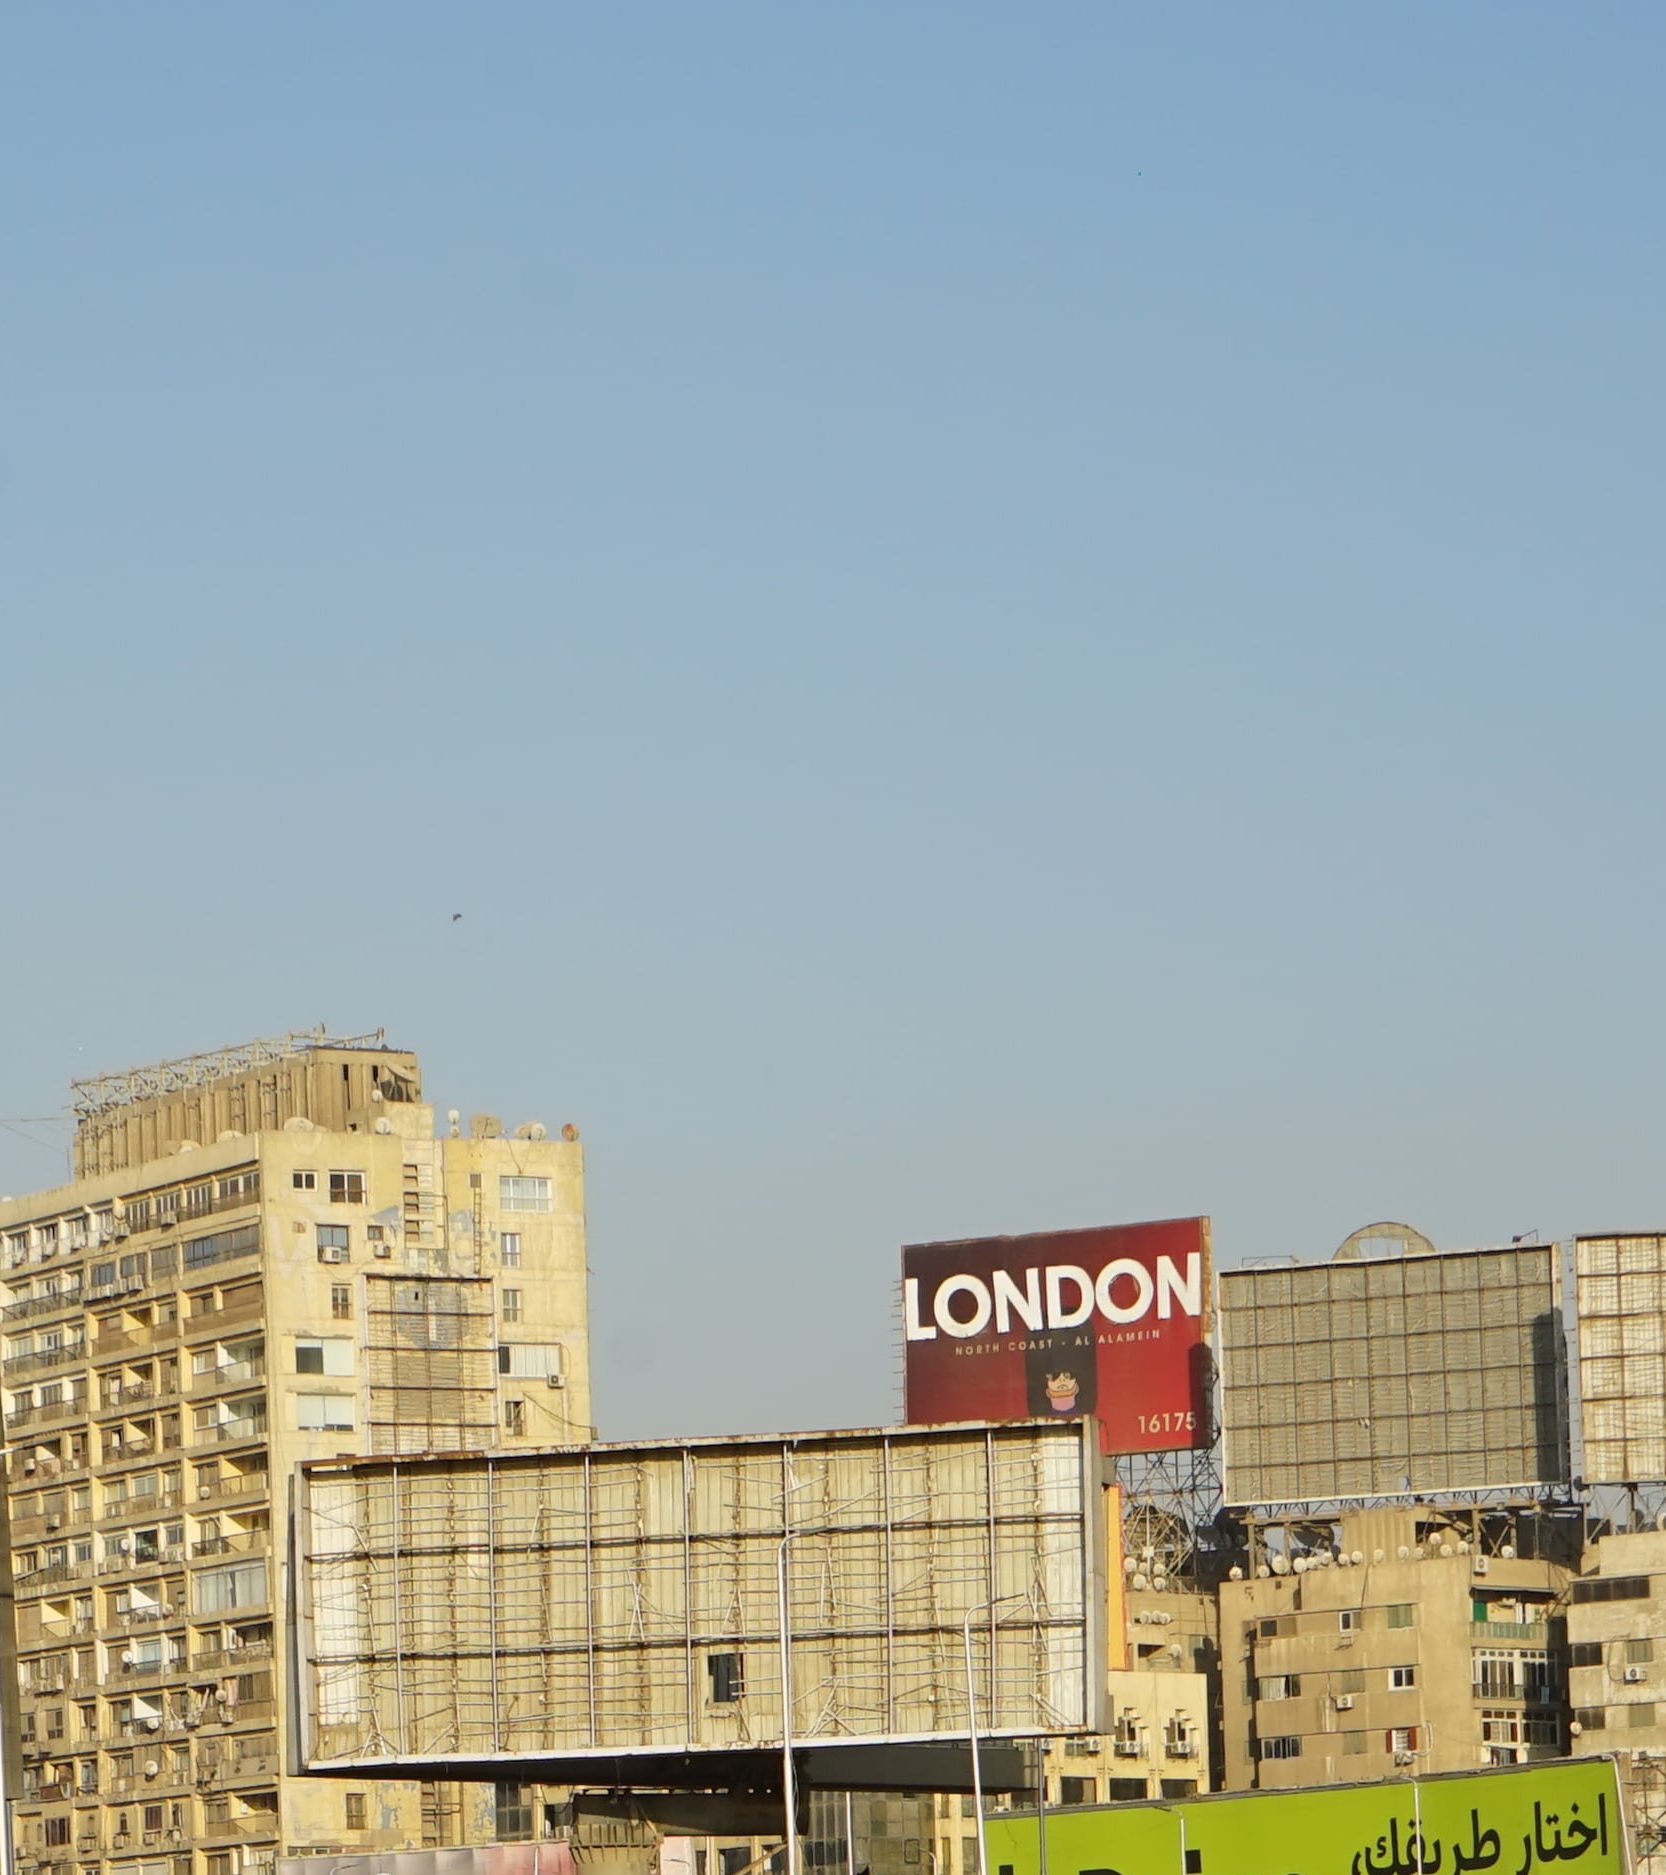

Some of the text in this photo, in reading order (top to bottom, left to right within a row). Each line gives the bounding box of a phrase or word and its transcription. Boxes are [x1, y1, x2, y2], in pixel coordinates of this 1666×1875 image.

[904, 1251, 1202, 1342] LONDON
[955, 1329, 1161, 1356] NORTH COAST AL ALAMEIN
[1137, 1410, 1198, 1435] 16175
